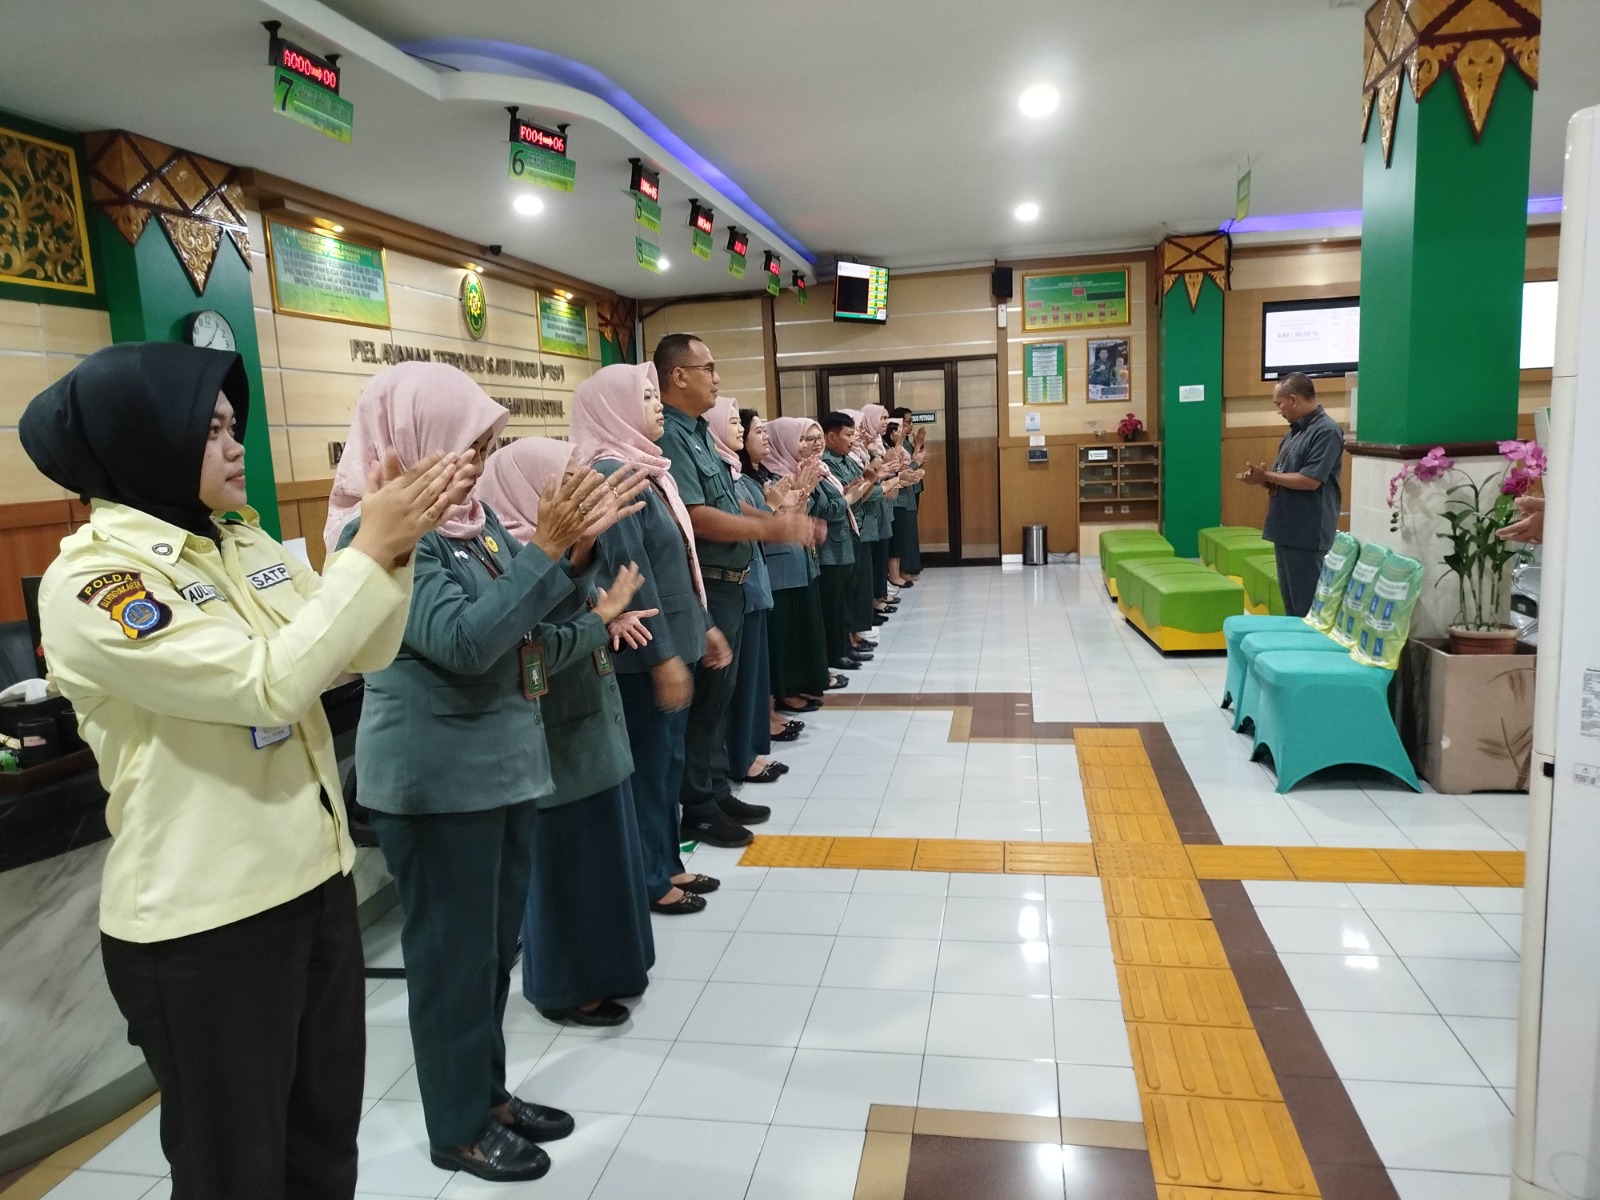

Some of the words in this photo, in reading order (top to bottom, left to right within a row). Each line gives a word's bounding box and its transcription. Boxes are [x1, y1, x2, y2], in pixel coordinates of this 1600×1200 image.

[278, 74, 294, 112] 7
[512, 149, 525, 176] 6
[84, 574, 133, 597] POLDA
[251, 566, 287, 587] SATP
